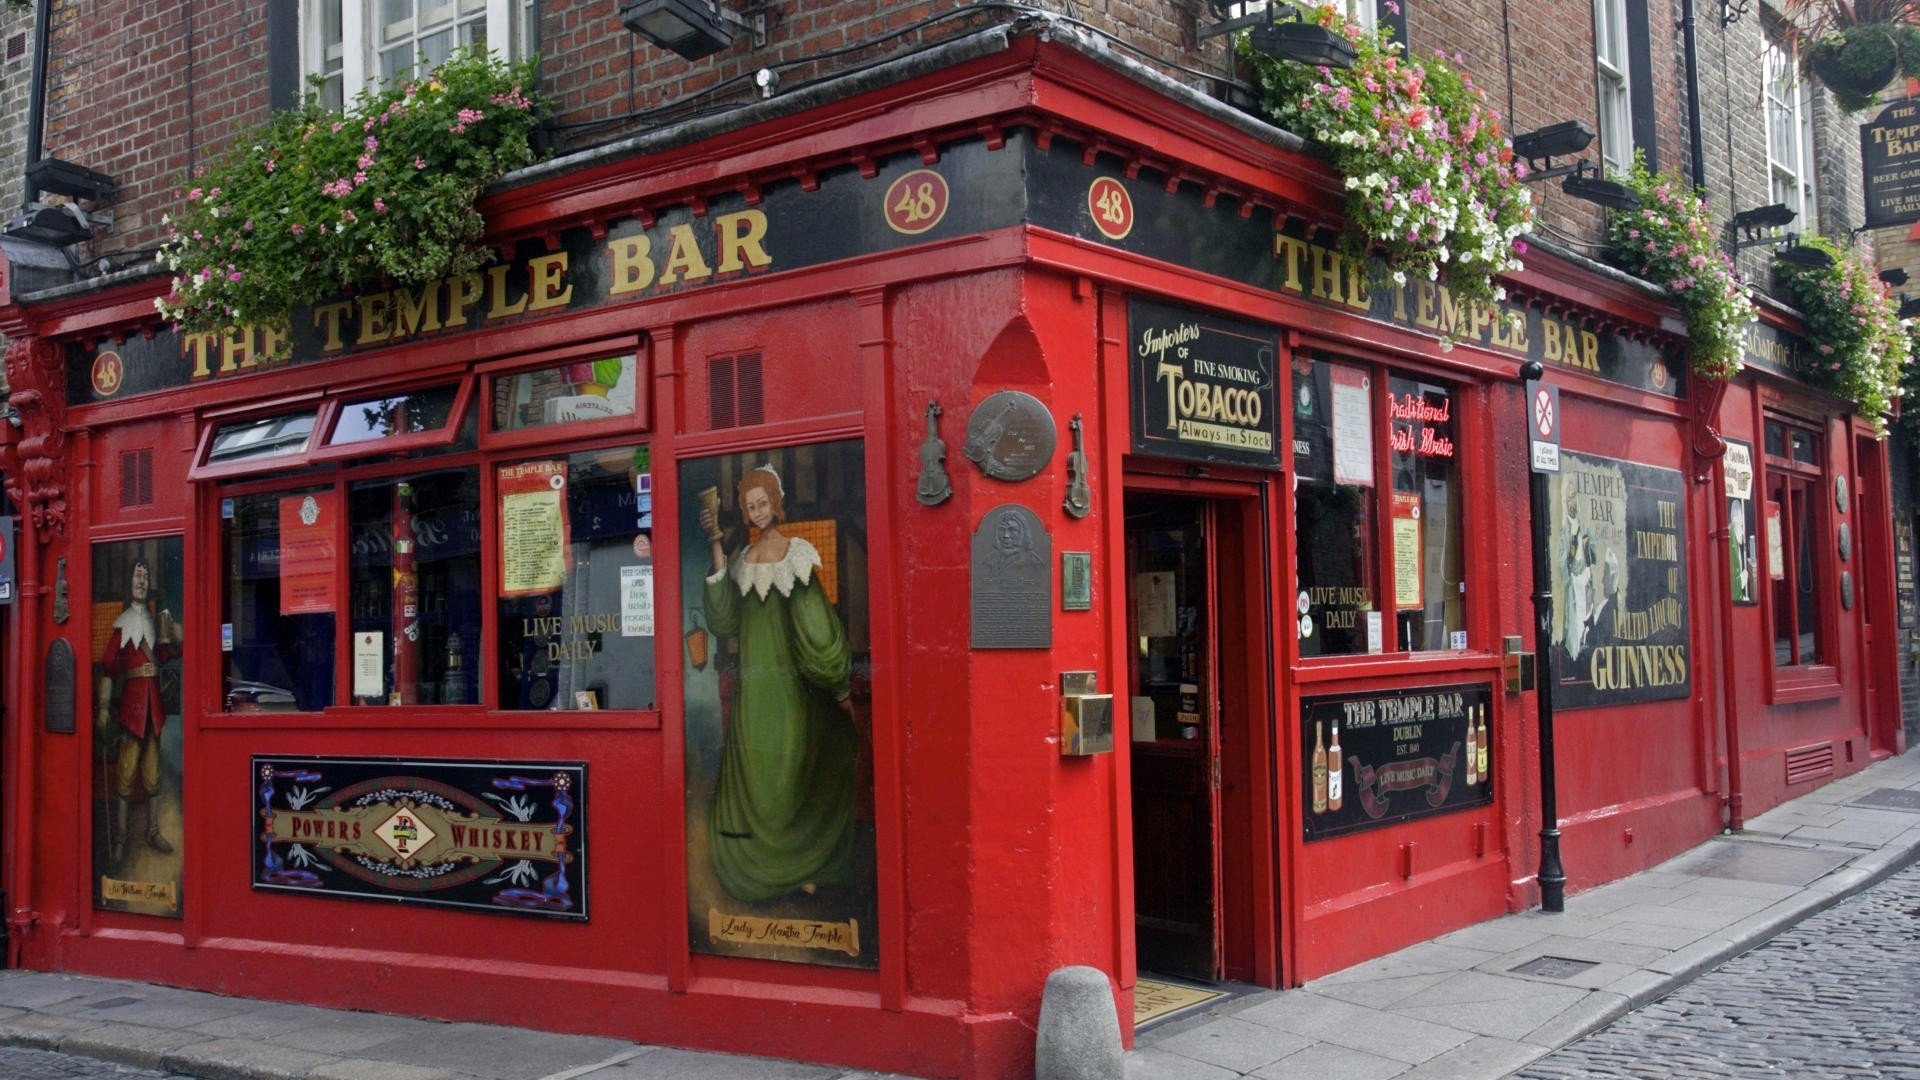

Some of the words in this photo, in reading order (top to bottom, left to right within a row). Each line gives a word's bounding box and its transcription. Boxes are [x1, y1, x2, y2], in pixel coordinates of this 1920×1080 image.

[1892, 106, 1917, 119] THE
[1873, 172, 1899, 184] BEER
[894, 182, 937, 223] 48
[1096, 185, 1125, 225] 48
[1880, 197, 1903, 208] LIVE
[314, 251, 573, 352] TEMPLE
[607, 209, 772, 295] BAR
[1139, 322, 1200, 361] Importers
[1177, 346, 1190, 359] OF
[1541, 316, 1600, 372] BAR
[96, 360, 117, 389] 48
[1194, 358, 1216, 378] FINE
[1217, 364, 1261, 385] SMOKING
[1156, 361, 1262, 430] TOBACCO
[1388, 393, 1450, 421] Traditional
[1180, 420, 1221, 442] Always
[1226, 426, 1237, 443] in
[1240, 429, 1271, 449] Stock
[1419, 427, 1453, 457] Music
[502, 469, 515, 478] THE
[517, 465, 543, 476] TEMPLE
[1573, 470, 1625, 499] TEMPLE
[1590, 498, 1615, 525] BAR
[1657, 500, 1677, 528] THE
[1637, 530, 1678, 562] EMPEROR
[1667, 567, 1678, 594] OF
[1310, 586, 1336, 605] LIVE
[1340, 586, 1371, 605] MUSIC
[523, 616, 562, 637] LIVE
[570, 612, 622, 634] MUSIC
[1326, 610, 1357, 628] DAILY
[1612, 608, 1649, 641] MALTED
[1649, 597, 1682, 635] LIQUORS
[547, 640, 598, 661] DAILY
[1590, 645, 1686, 691] GUINNESS
[1343, 700, 1376, 728] THE
[1379, 694, 1435, 726] TEMPLE
[1438, 692, 1464, 719] BAR
[1393, 724, 1423, 741] DUBLIN
[1379, 772, 1395, 786] LIVE
[1396, 769, 1416, 782] MUSIC
[292, 816, 362, 841] POWERS
[450, 823, 544, 851] WHISKEY
[721, 918, 752, 937] Lady
[803, 924, 843, 944] Temple
